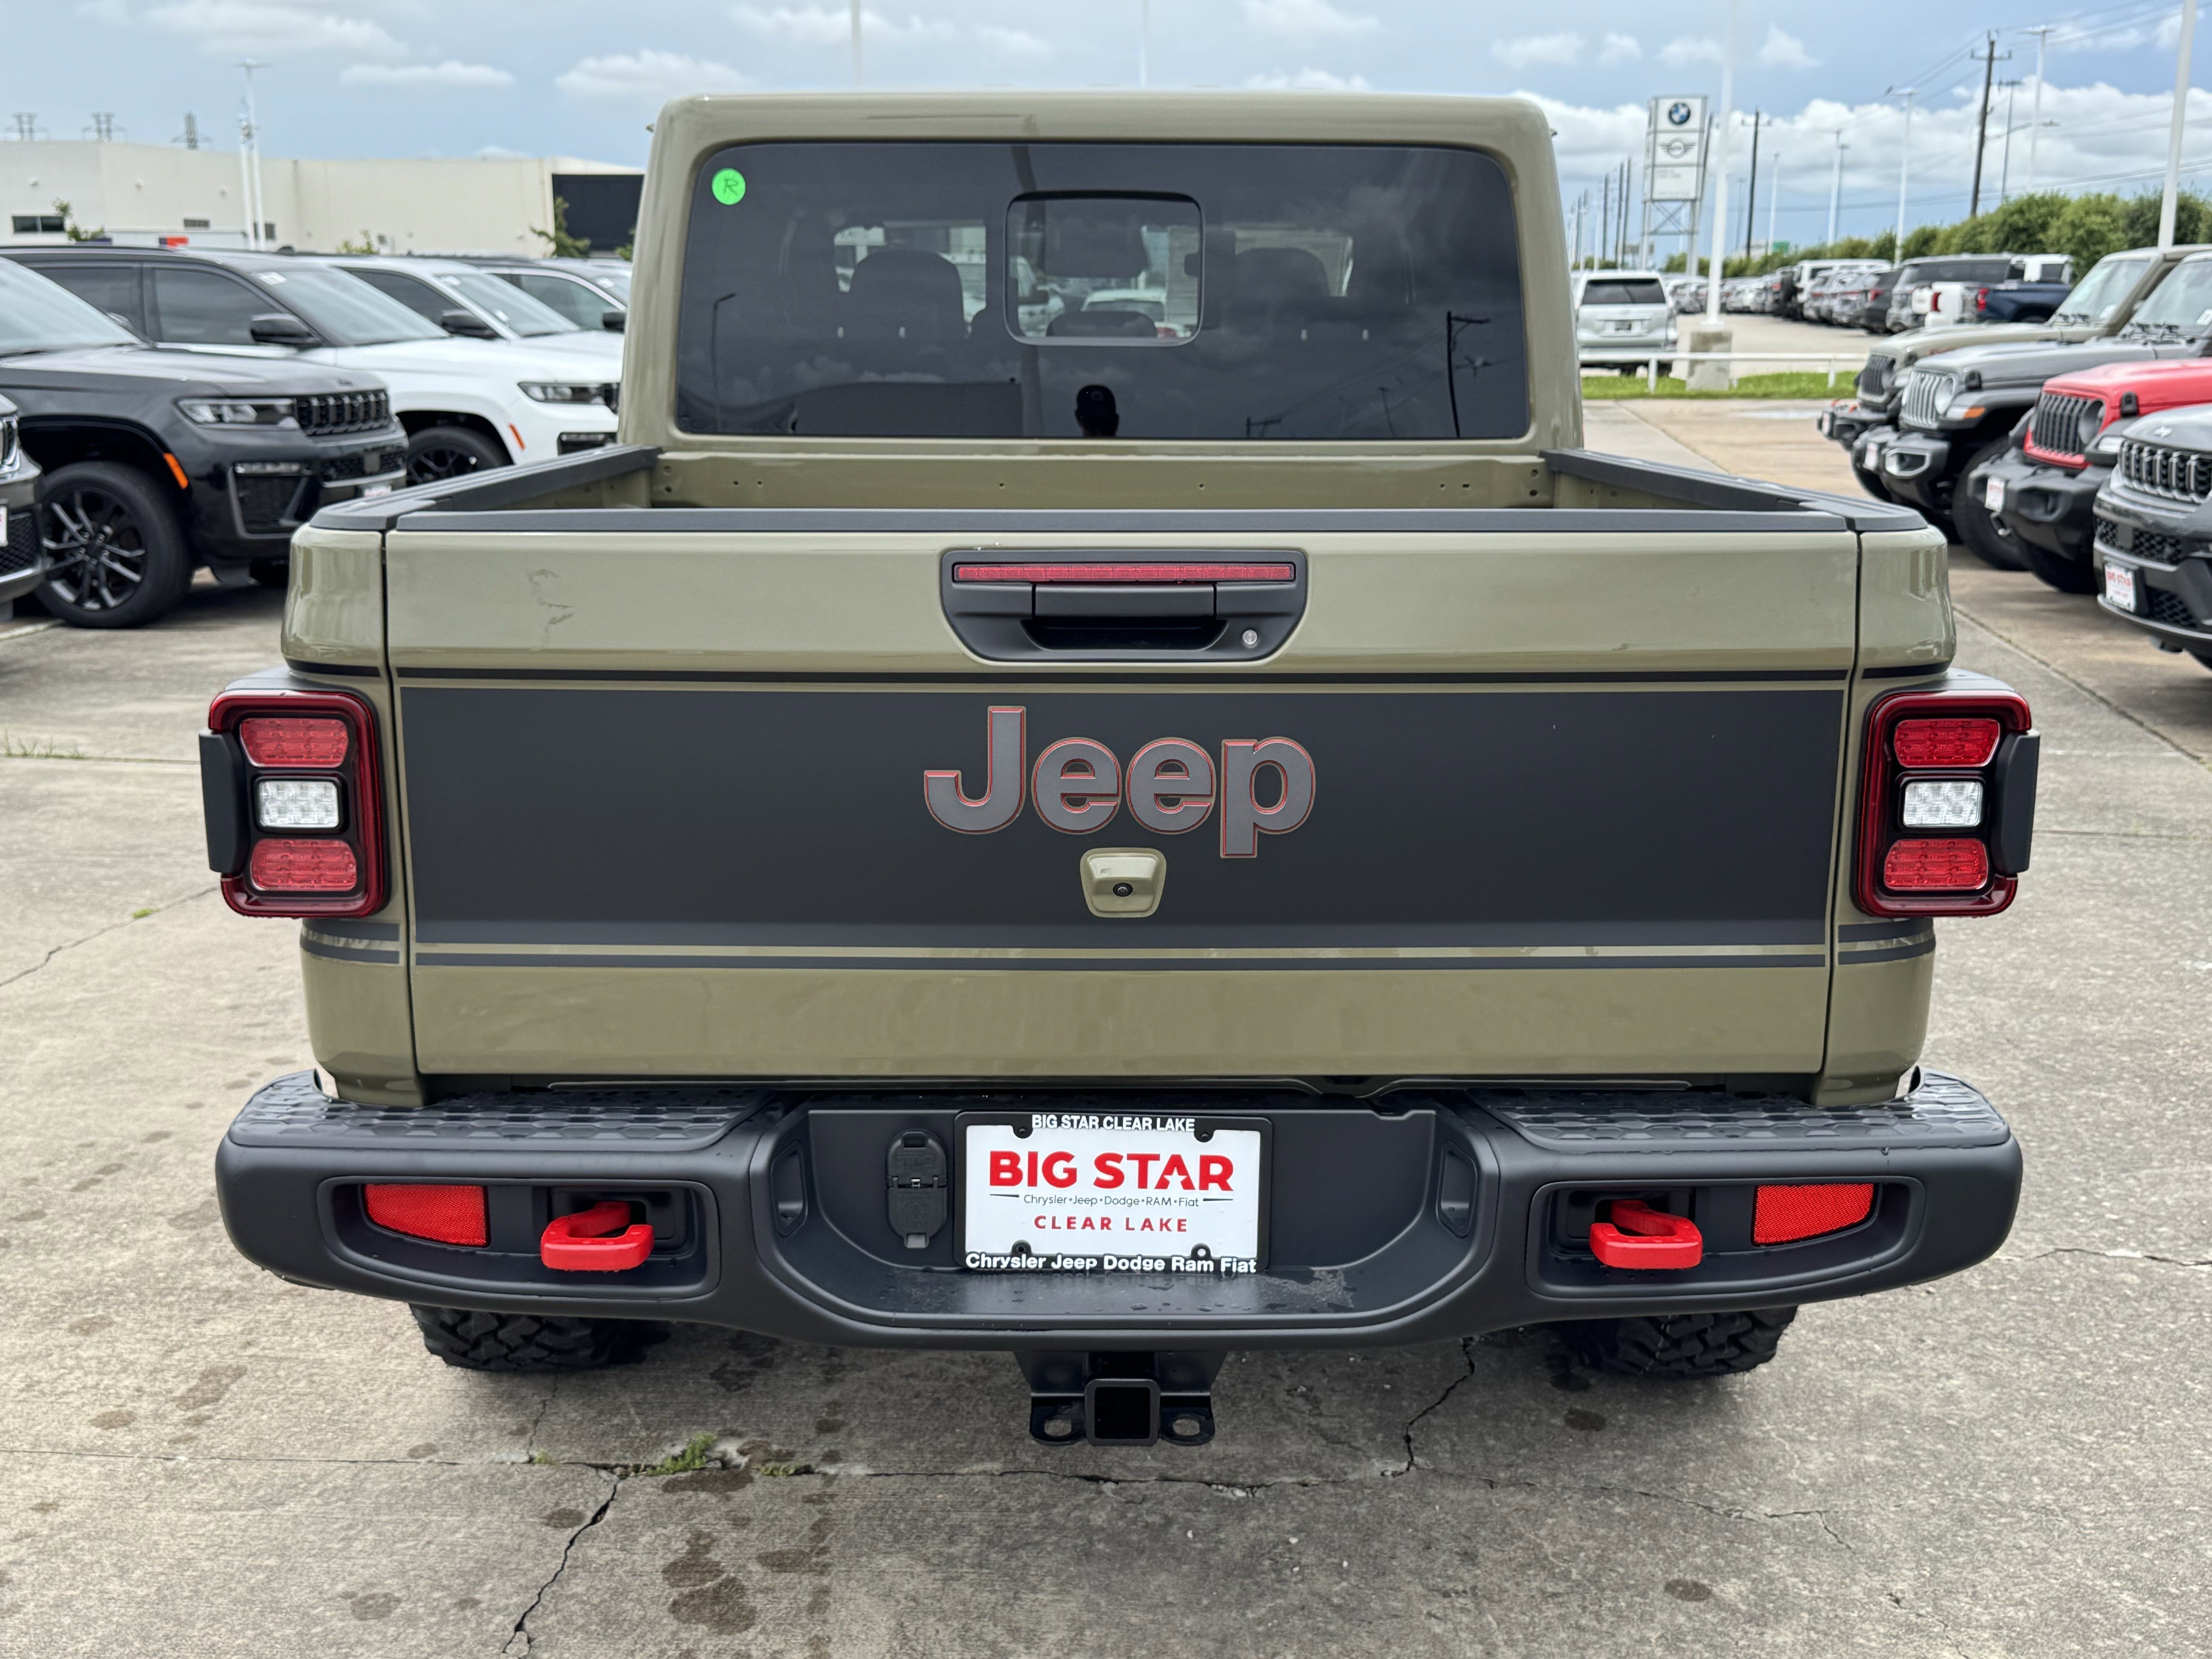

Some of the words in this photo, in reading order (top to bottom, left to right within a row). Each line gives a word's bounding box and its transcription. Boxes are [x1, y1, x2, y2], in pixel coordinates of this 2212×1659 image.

[924, 706, 1316, 858] Jeep
[1032, 1115, 1057, 1128] BIG
[1061, 1115, 1099, 1129] STAR
[1103, 1116, 1152, 1130] CLEAR
[1156, 1118, 1195, 1131] LAKE
[989, 1151, 1077, 1188] BIG
[1093, 1152, 1234, 1191] STAR
[1024, 1194, 1067, 1206] Chrysler
[1072, 1195, 1098, 1206] Jeep
[1104, 1196, 1139, 1207] Dodge
[1146, 1197, 1172, 1206] RAM
[1179, 1197, 1199, 1207] Fiat
[1034, 1215, 1112, 1230] CLEAR
[1125, 1217, 1187, 1232] LAKE
[966, 1253, 1046, 1269] Chrysler
[1051, 1254, 1097, 1270] Jeep
[1104, 1255, 1166, 1271] Dodge
[1171, 1257, 1214, 1272] Ram
[1220, 1257, 1256, 1273] Fiat
